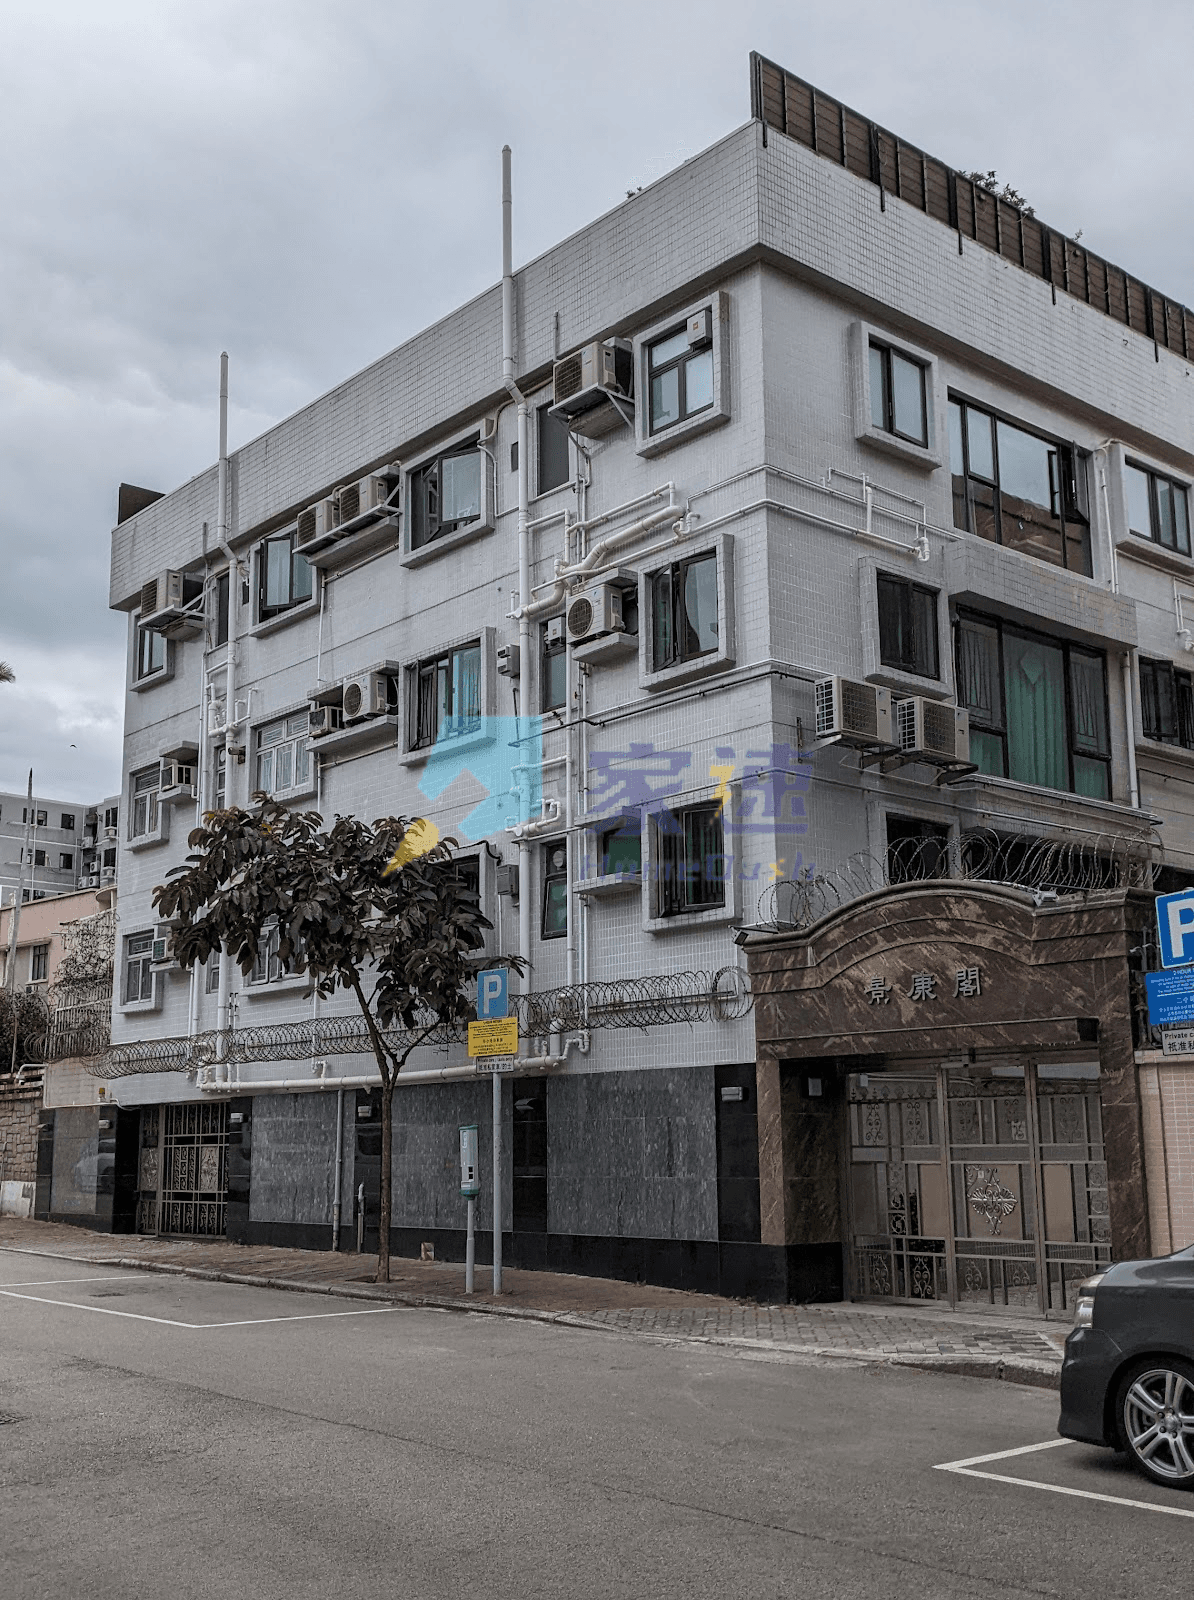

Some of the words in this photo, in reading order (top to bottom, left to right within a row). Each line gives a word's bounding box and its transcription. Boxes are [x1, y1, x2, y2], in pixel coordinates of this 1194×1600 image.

[1167, 898, 1194, 958] P
[483, 975, 502, 1014] P
[863, 966, 981, 1005] 景康閣
[1165, 1032, 1188, 1040] Private
